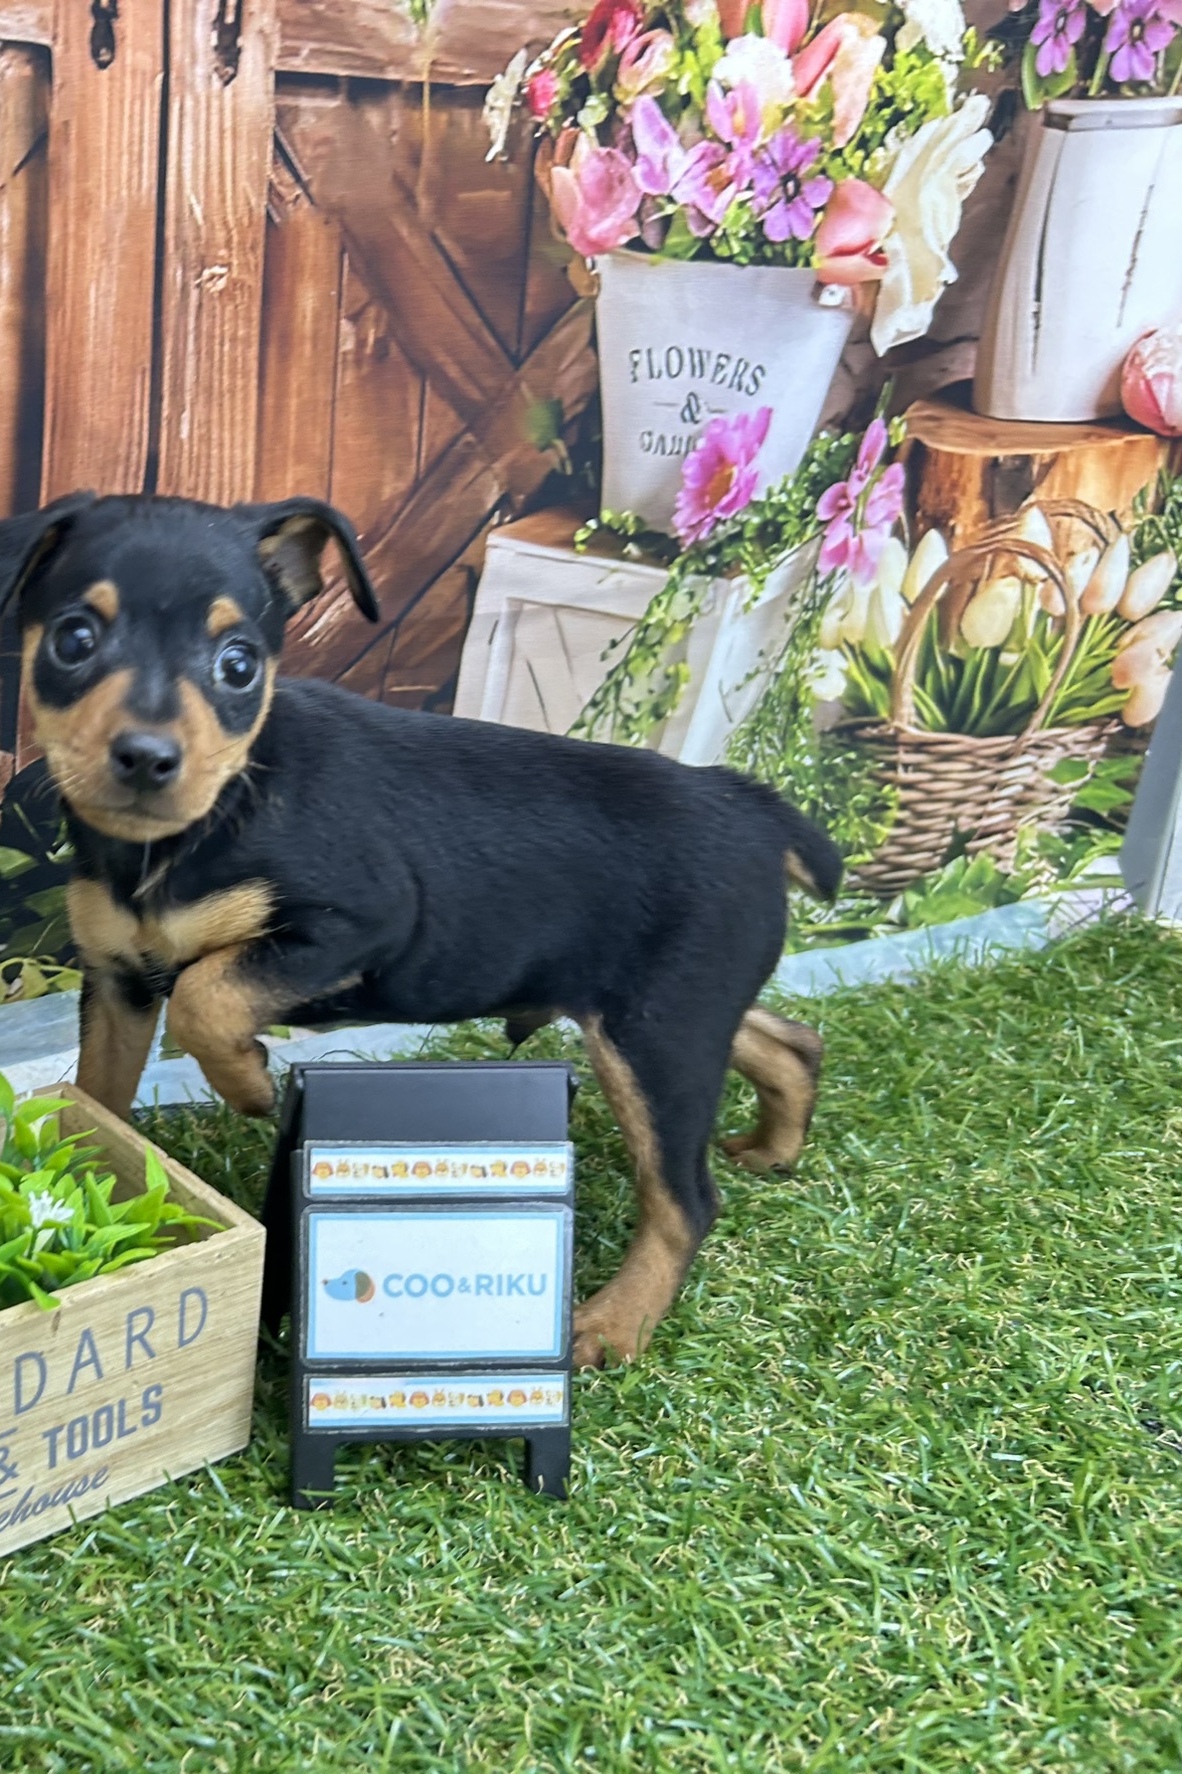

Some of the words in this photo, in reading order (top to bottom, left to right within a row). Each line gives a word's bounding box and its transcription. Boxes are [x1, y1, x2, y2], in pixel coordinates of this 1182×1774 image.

[628, 345, 767, 397] FLOWERS
[680, 391, 702, 425] &
[42, 1383, 164, 1469] TOOLS
